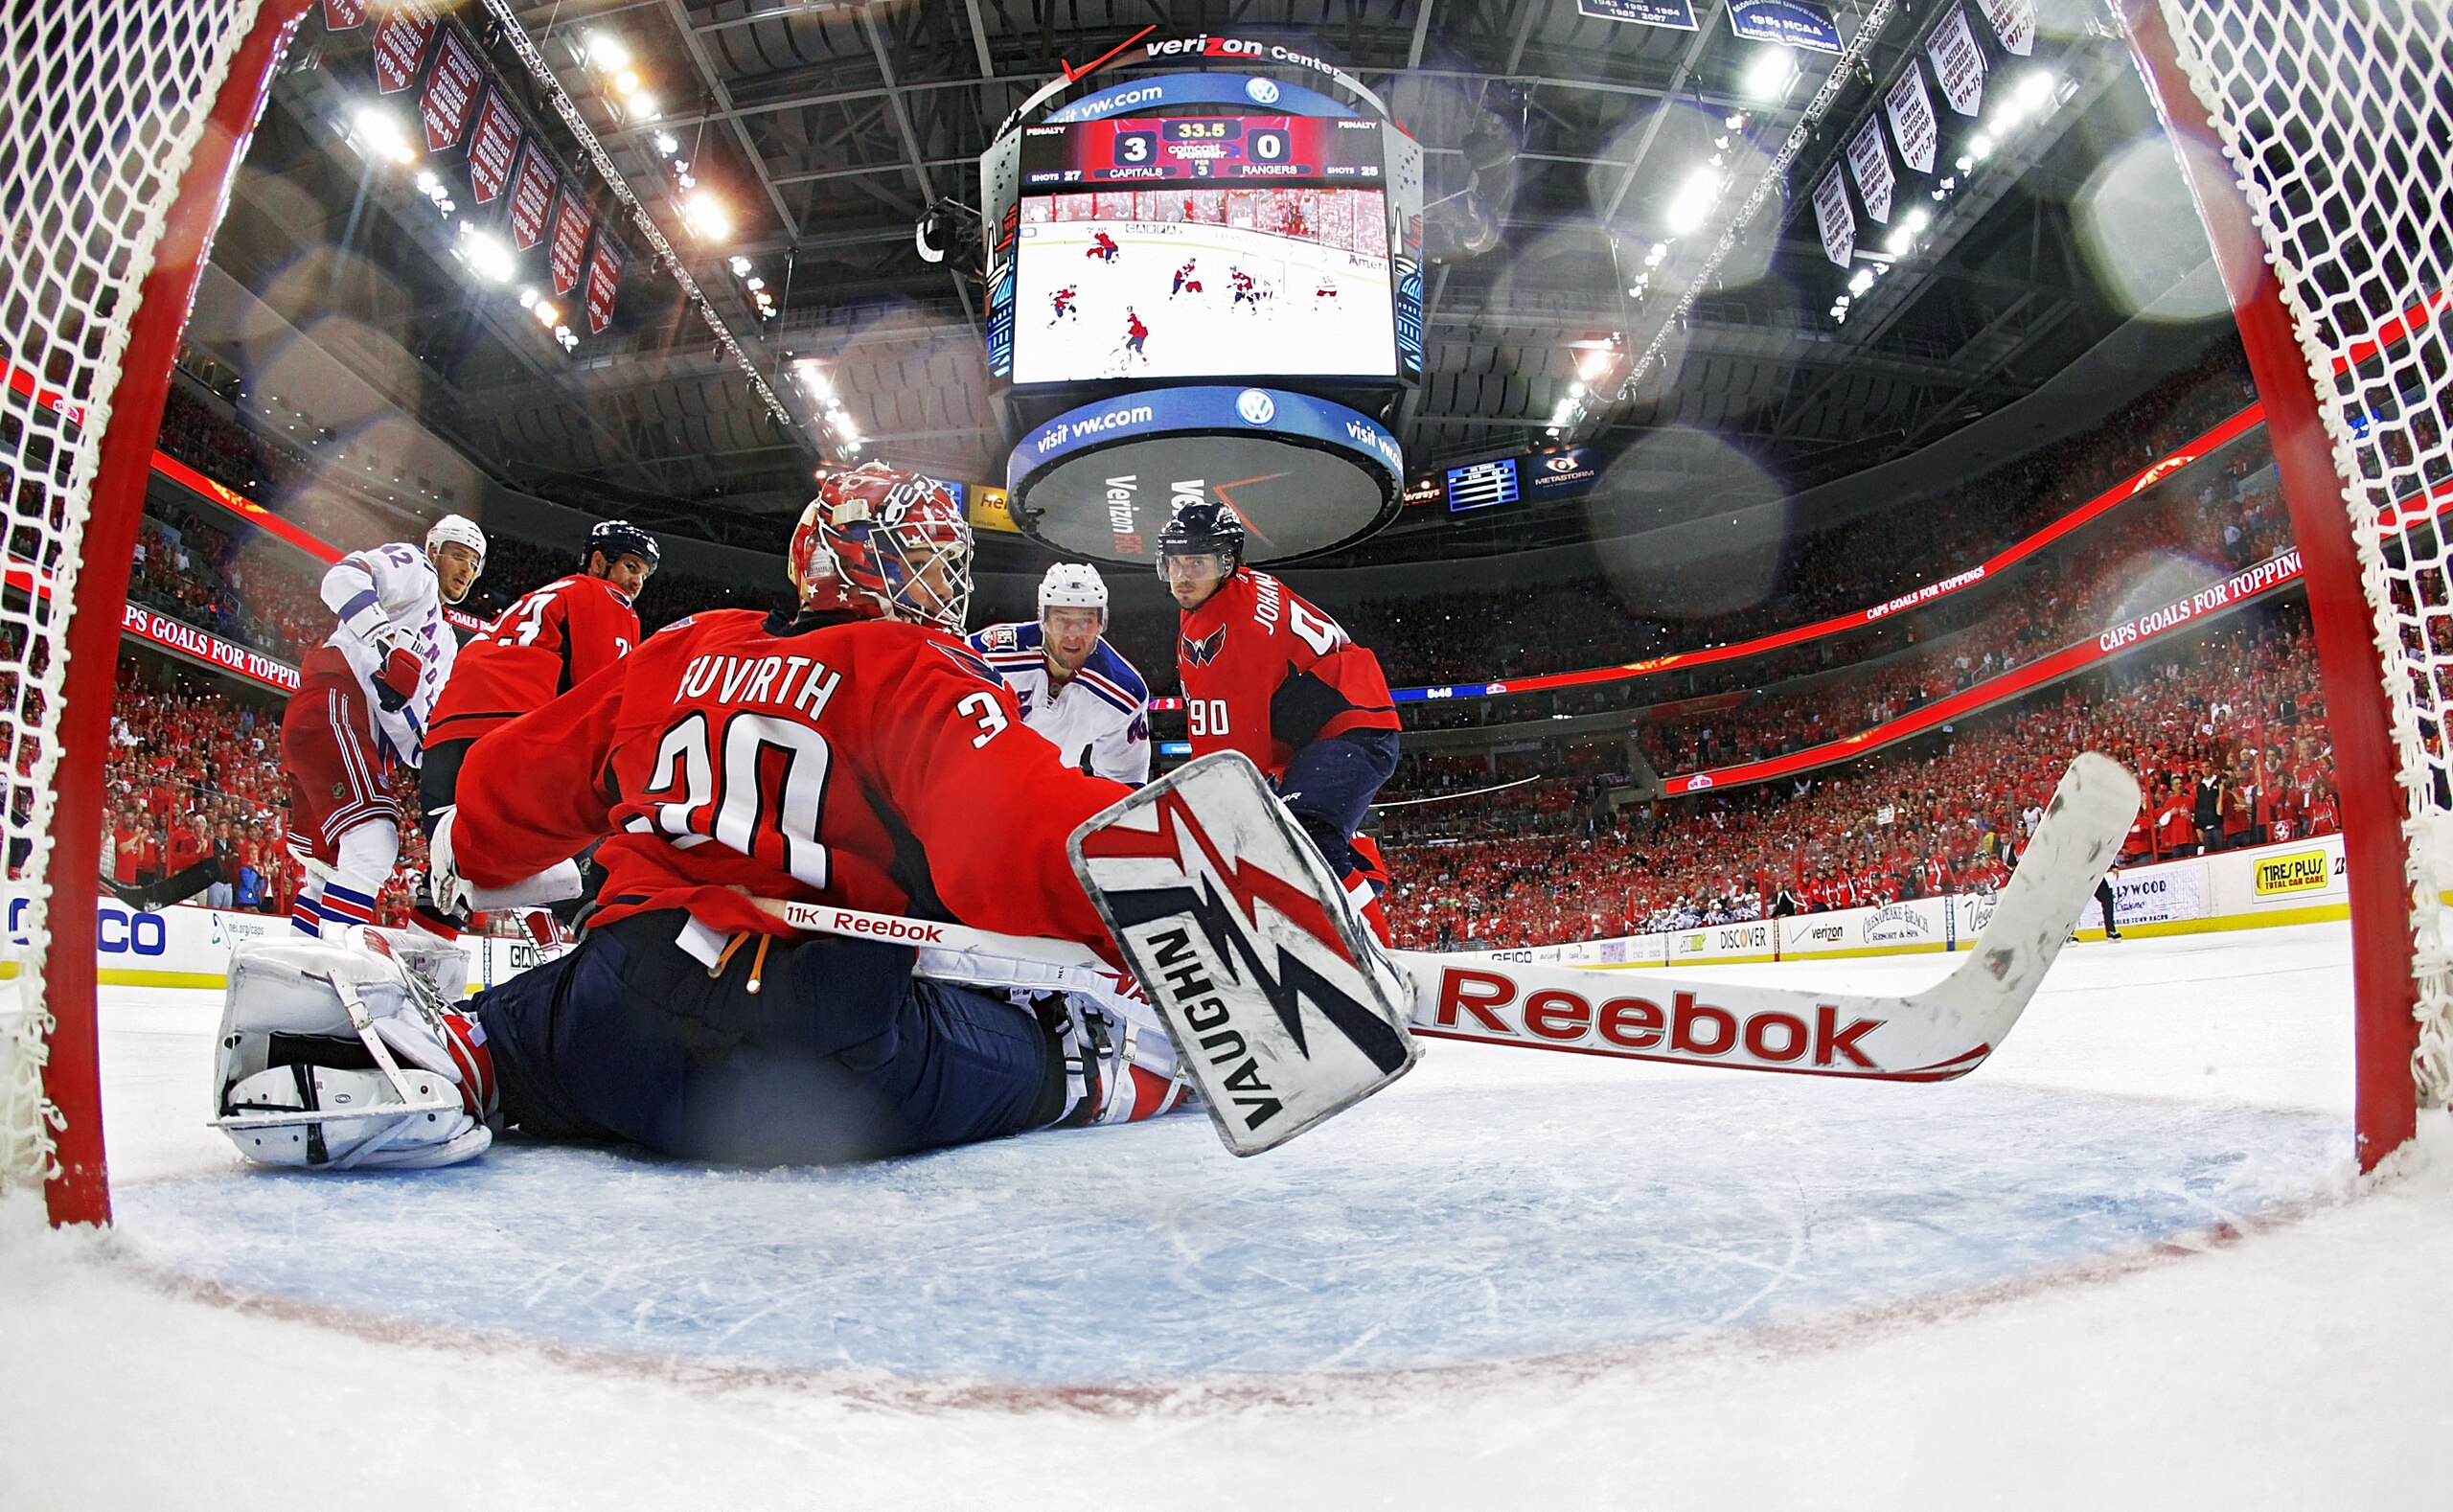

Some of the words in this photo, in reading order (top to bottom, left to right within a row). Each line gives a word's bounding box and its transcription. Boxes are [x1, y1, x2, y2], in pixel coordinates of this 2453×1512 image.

[390, 21, 416, 57] DIVISION
[392, 7, 424, 48] SOUTHEAST
[1782, 19, 1823, 36] NCAA
[1785, 34, 1838, 51] CHAMPIONS
[1926, 1, 1962, 52] WASHINGTON
[1937, 21, 1960, 55] BULLETS
[377, 48, 406, 87] 1999-00
[382, 30, 415, 73] CHAMPIONS
[447, 34, 479, 83] WASHINGTON
[1146, 34, 1262, 58] verizon
[1272, 45, 1341, 78] Center
[1942, 37, 1965, 69] EASTERN
[439, 66, 468, 104] SOUTHEAST
[447, 55, 470, 87] CAPITALS
[1887, 63, 1917, 107] BALTIMORE
[429, 88, 460, 129] CHAMPIONS
[437, 80, 461, 114] DIVISION
[1082, 86, 1162, 119] vw.com
[1895, 81, 1915, 112] BULLETS
[1900, 97, 1921, 126] CENTRAL
[426, 108, 452, 145] 2000-01
[1027, 126, 1066, 136] PENALTY
[1179, 123, 1226, 138] 33.5
[1339, 121, 1377, 129] PENALTY
[1902, 105, 1925, 139] DIVISION
[1903, 113, 1931, 152] CHAMPIONS
[482, 135, 505, 168] DIVISION
[484, 122, 510, 158] SOUTHEAST
[1124, 137, 1147, 161] 3
[1257, 134, 1281, 158] 0
[472, 162, 497, 196] 2007-08
[476, 144, 504, 182] CHAMPIONS
[1031, 173, 1060, 182] SHOTS
[1064, 171, 1082, 182] 27
[1110, 167, 1163, 178] CAPITALS
[1198, 166, 1208, 176] 3
[1243, 165, 1297, 175] RANGERS
[1327, 167, 1355, 175] SHOTS
[1362, 166, 1379, 177] 25
[1038, 424, 1068, 453] visit
[1072, 406, 1153, 438] vw.com
[1346, 420, 1376, 447] visit
[1535, 470, 1594, 486] METASTORM
[1105, 474, 1138, 534] Verizon
[1867, 603, 1889, 619] CAPS
[1890, 591, 1918, 610] GOALS
[1920, 585, 1938, 600] FOR
[1939, 565, 1985, 592] TOPPINGS
[447, 610, 477, 630] GOALS
[2099, 623, 2137, 653] CAPS
[2140, 599, 2190, 636] GOALS
[2192, 584, 2229, 615] FOR
[151, 616, 208, 655] GOALS
[211, 639, 245, 670] FOR
[1190, 699, 1229, 736] 90
[2263, 863, 2293, 882] TIRES
[2295, 858, 2324, 881] PLUS
[2265, 880, 2286, 889] TOTAL
[2288, 878, 2303, 886] CAR
[2304, 875, 2324, 885] CARE
[786, 905, 820, 926] 11K
[834, 912, 945, 944] Reebok
[1811, 924, 1844, 942] verizon
[1872, 931, 1897, 941] RESORT
[1904, 905, 1930, 934] BEACH
[1720, 927, 1766, 950] DISCOVER
[1146, 927, 1283, 1132] VAUGHN
[1434, 965, 1888, 1070] Reebok
